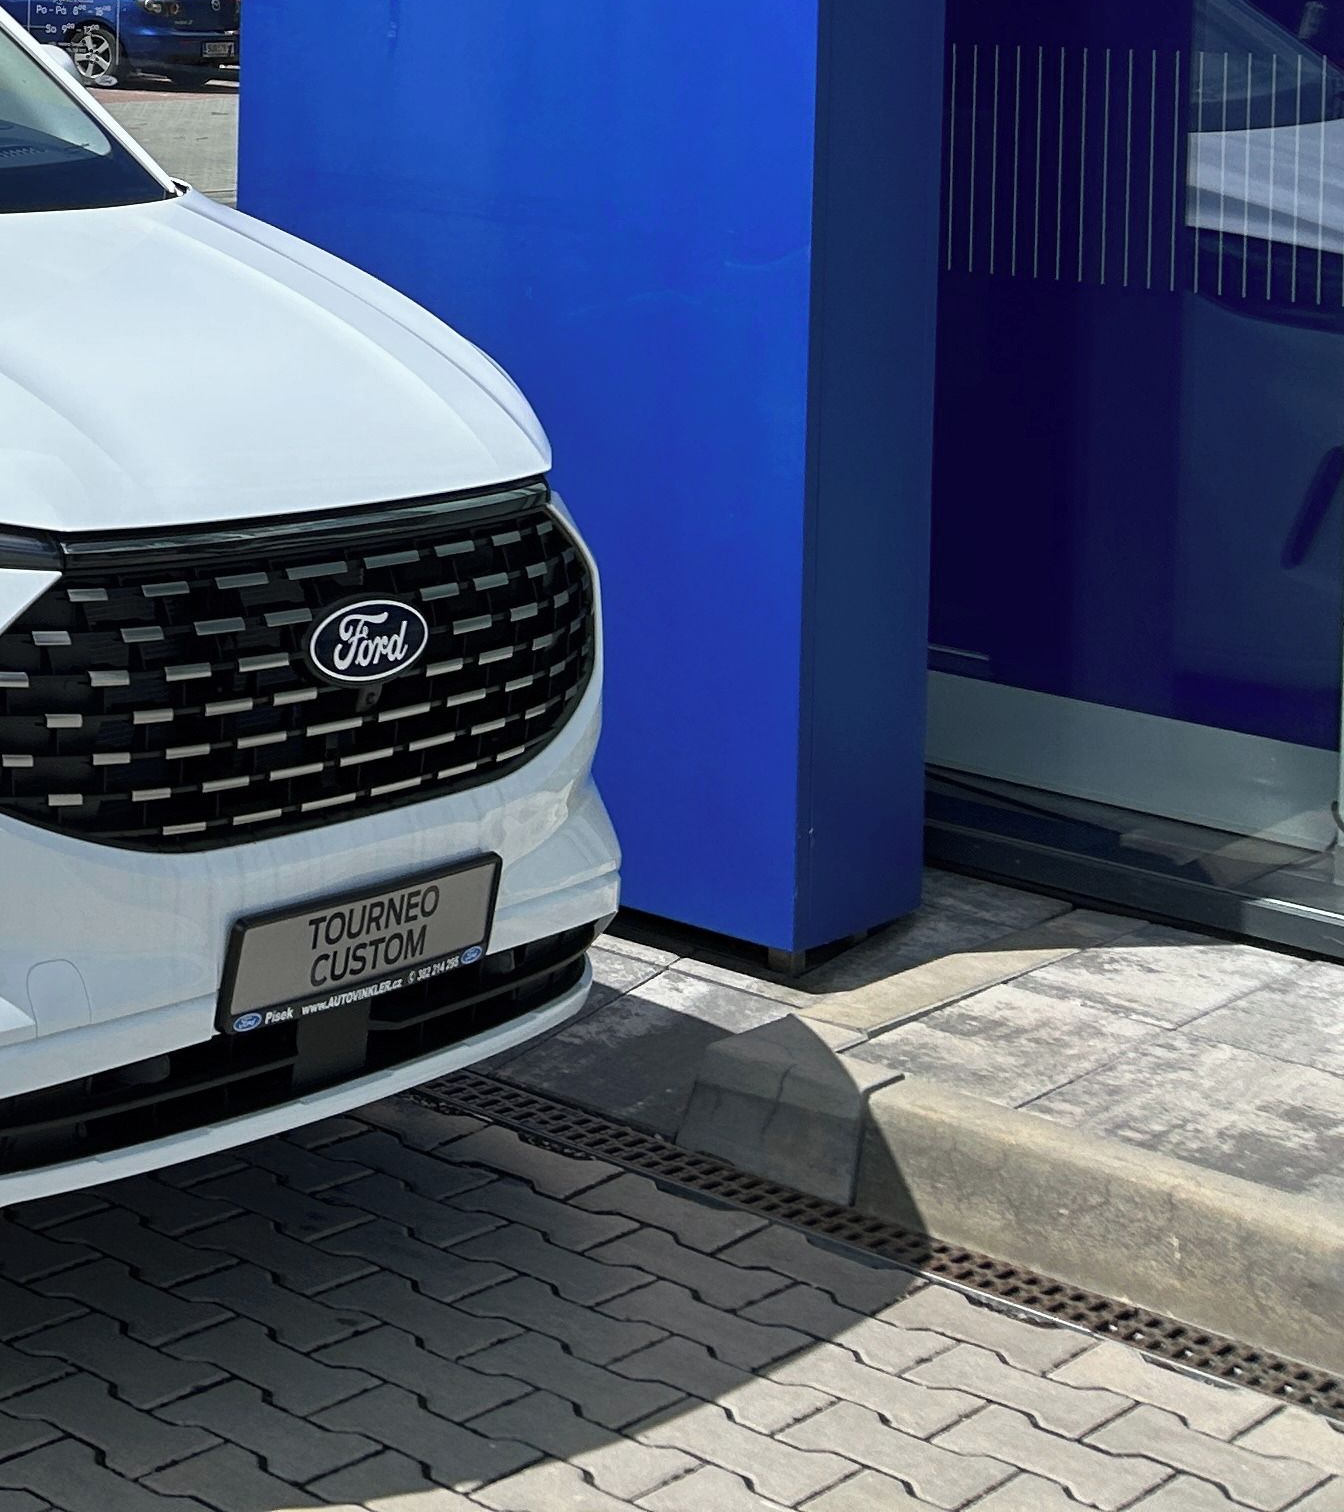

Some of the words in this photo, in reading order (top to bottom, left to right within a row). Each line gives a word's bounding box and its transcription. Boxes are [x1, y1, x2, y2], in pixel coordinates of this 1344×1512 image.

[36, 4, 47, 14] Po
[45, 24, 57, 34] So
[333, 611, 409, 671] Ford
[309, 885, 440, 950] TOURNEO
[310, 924, 428, 987] CUSTOM
[301, 978, 403, 1016] www.AUTOVINKLER.cz
